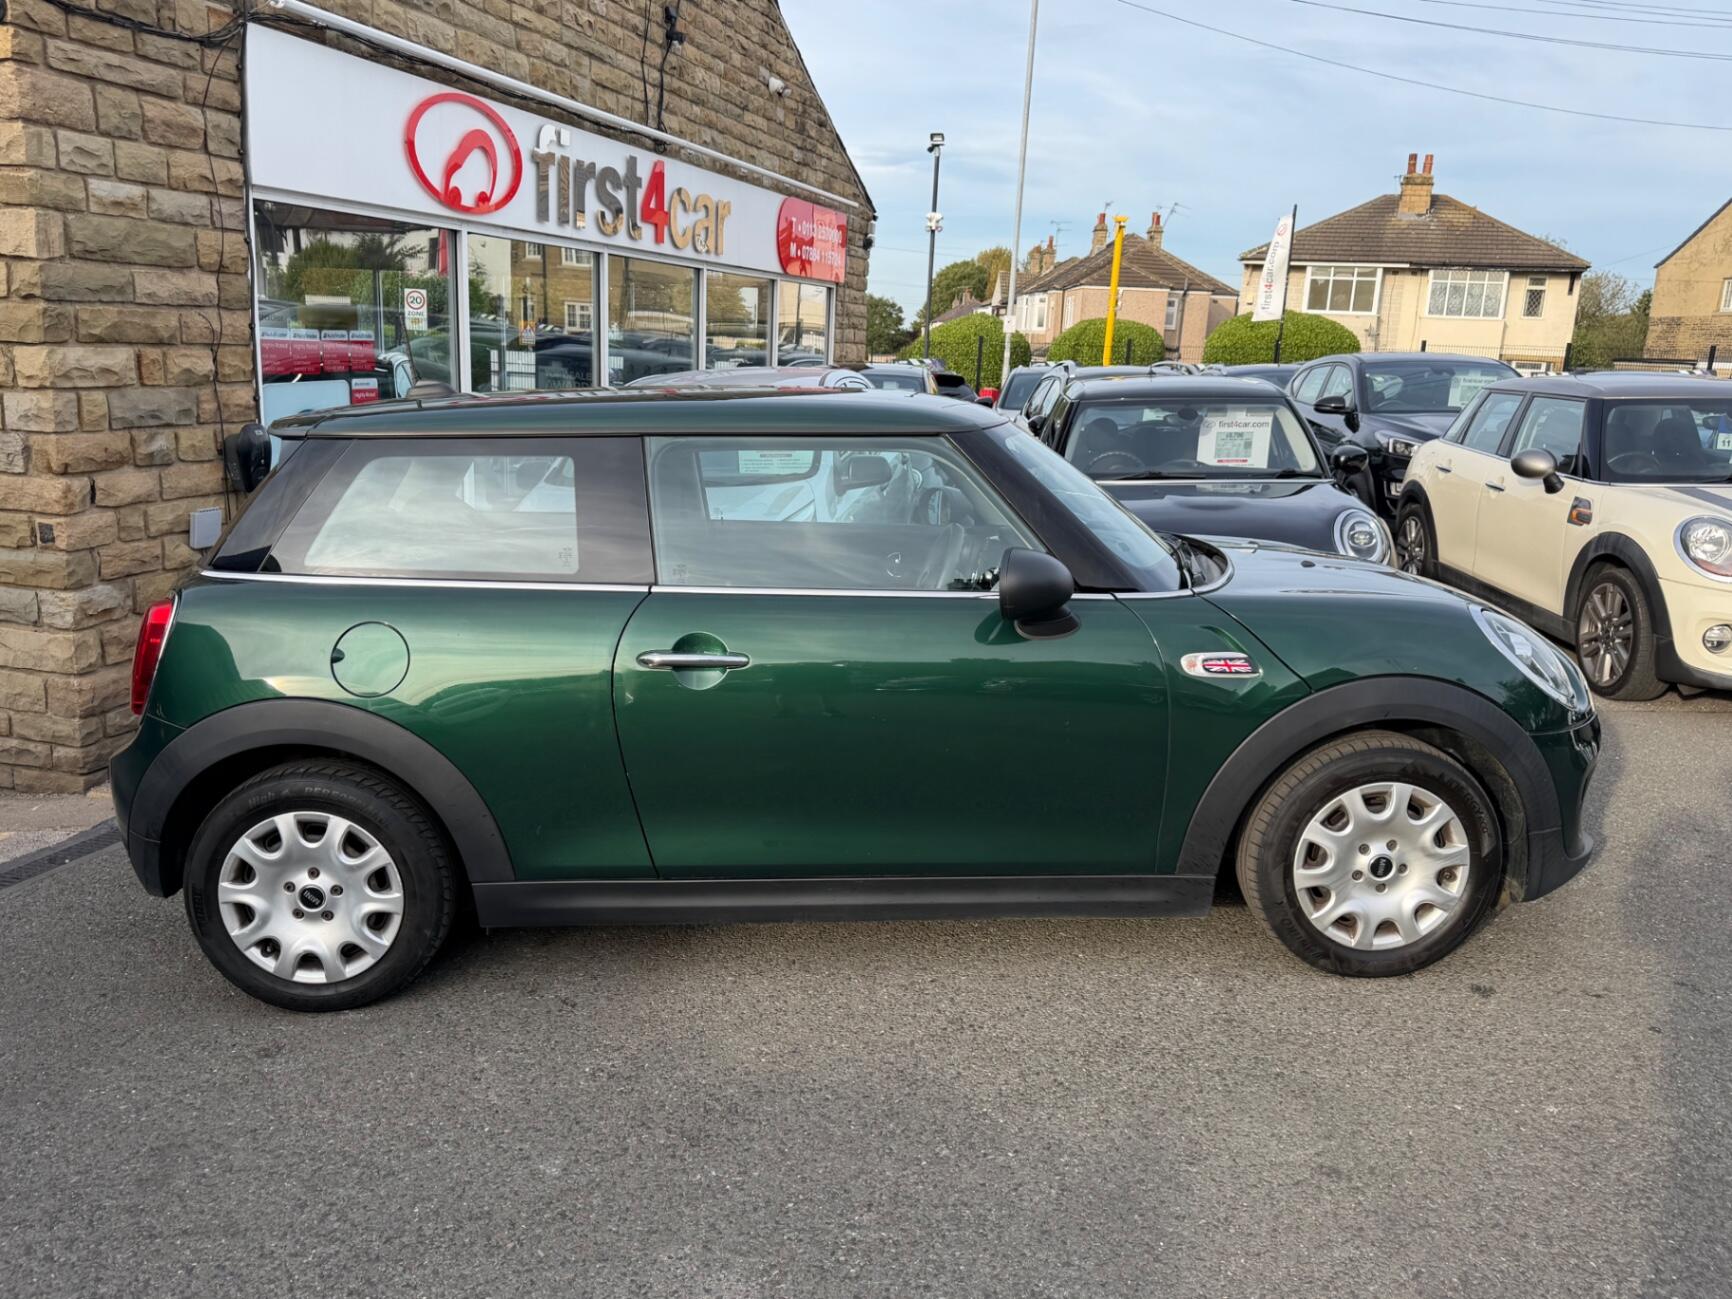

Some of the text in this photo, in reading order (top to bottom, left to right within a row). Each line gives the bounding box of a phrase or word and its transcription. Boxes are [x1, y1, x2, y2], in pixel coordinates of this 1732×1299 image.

[532, 124, 731, 256] first4car
[409, 295, 422, 304] 20
[1218, 420, 1270, 428] first4car.com
